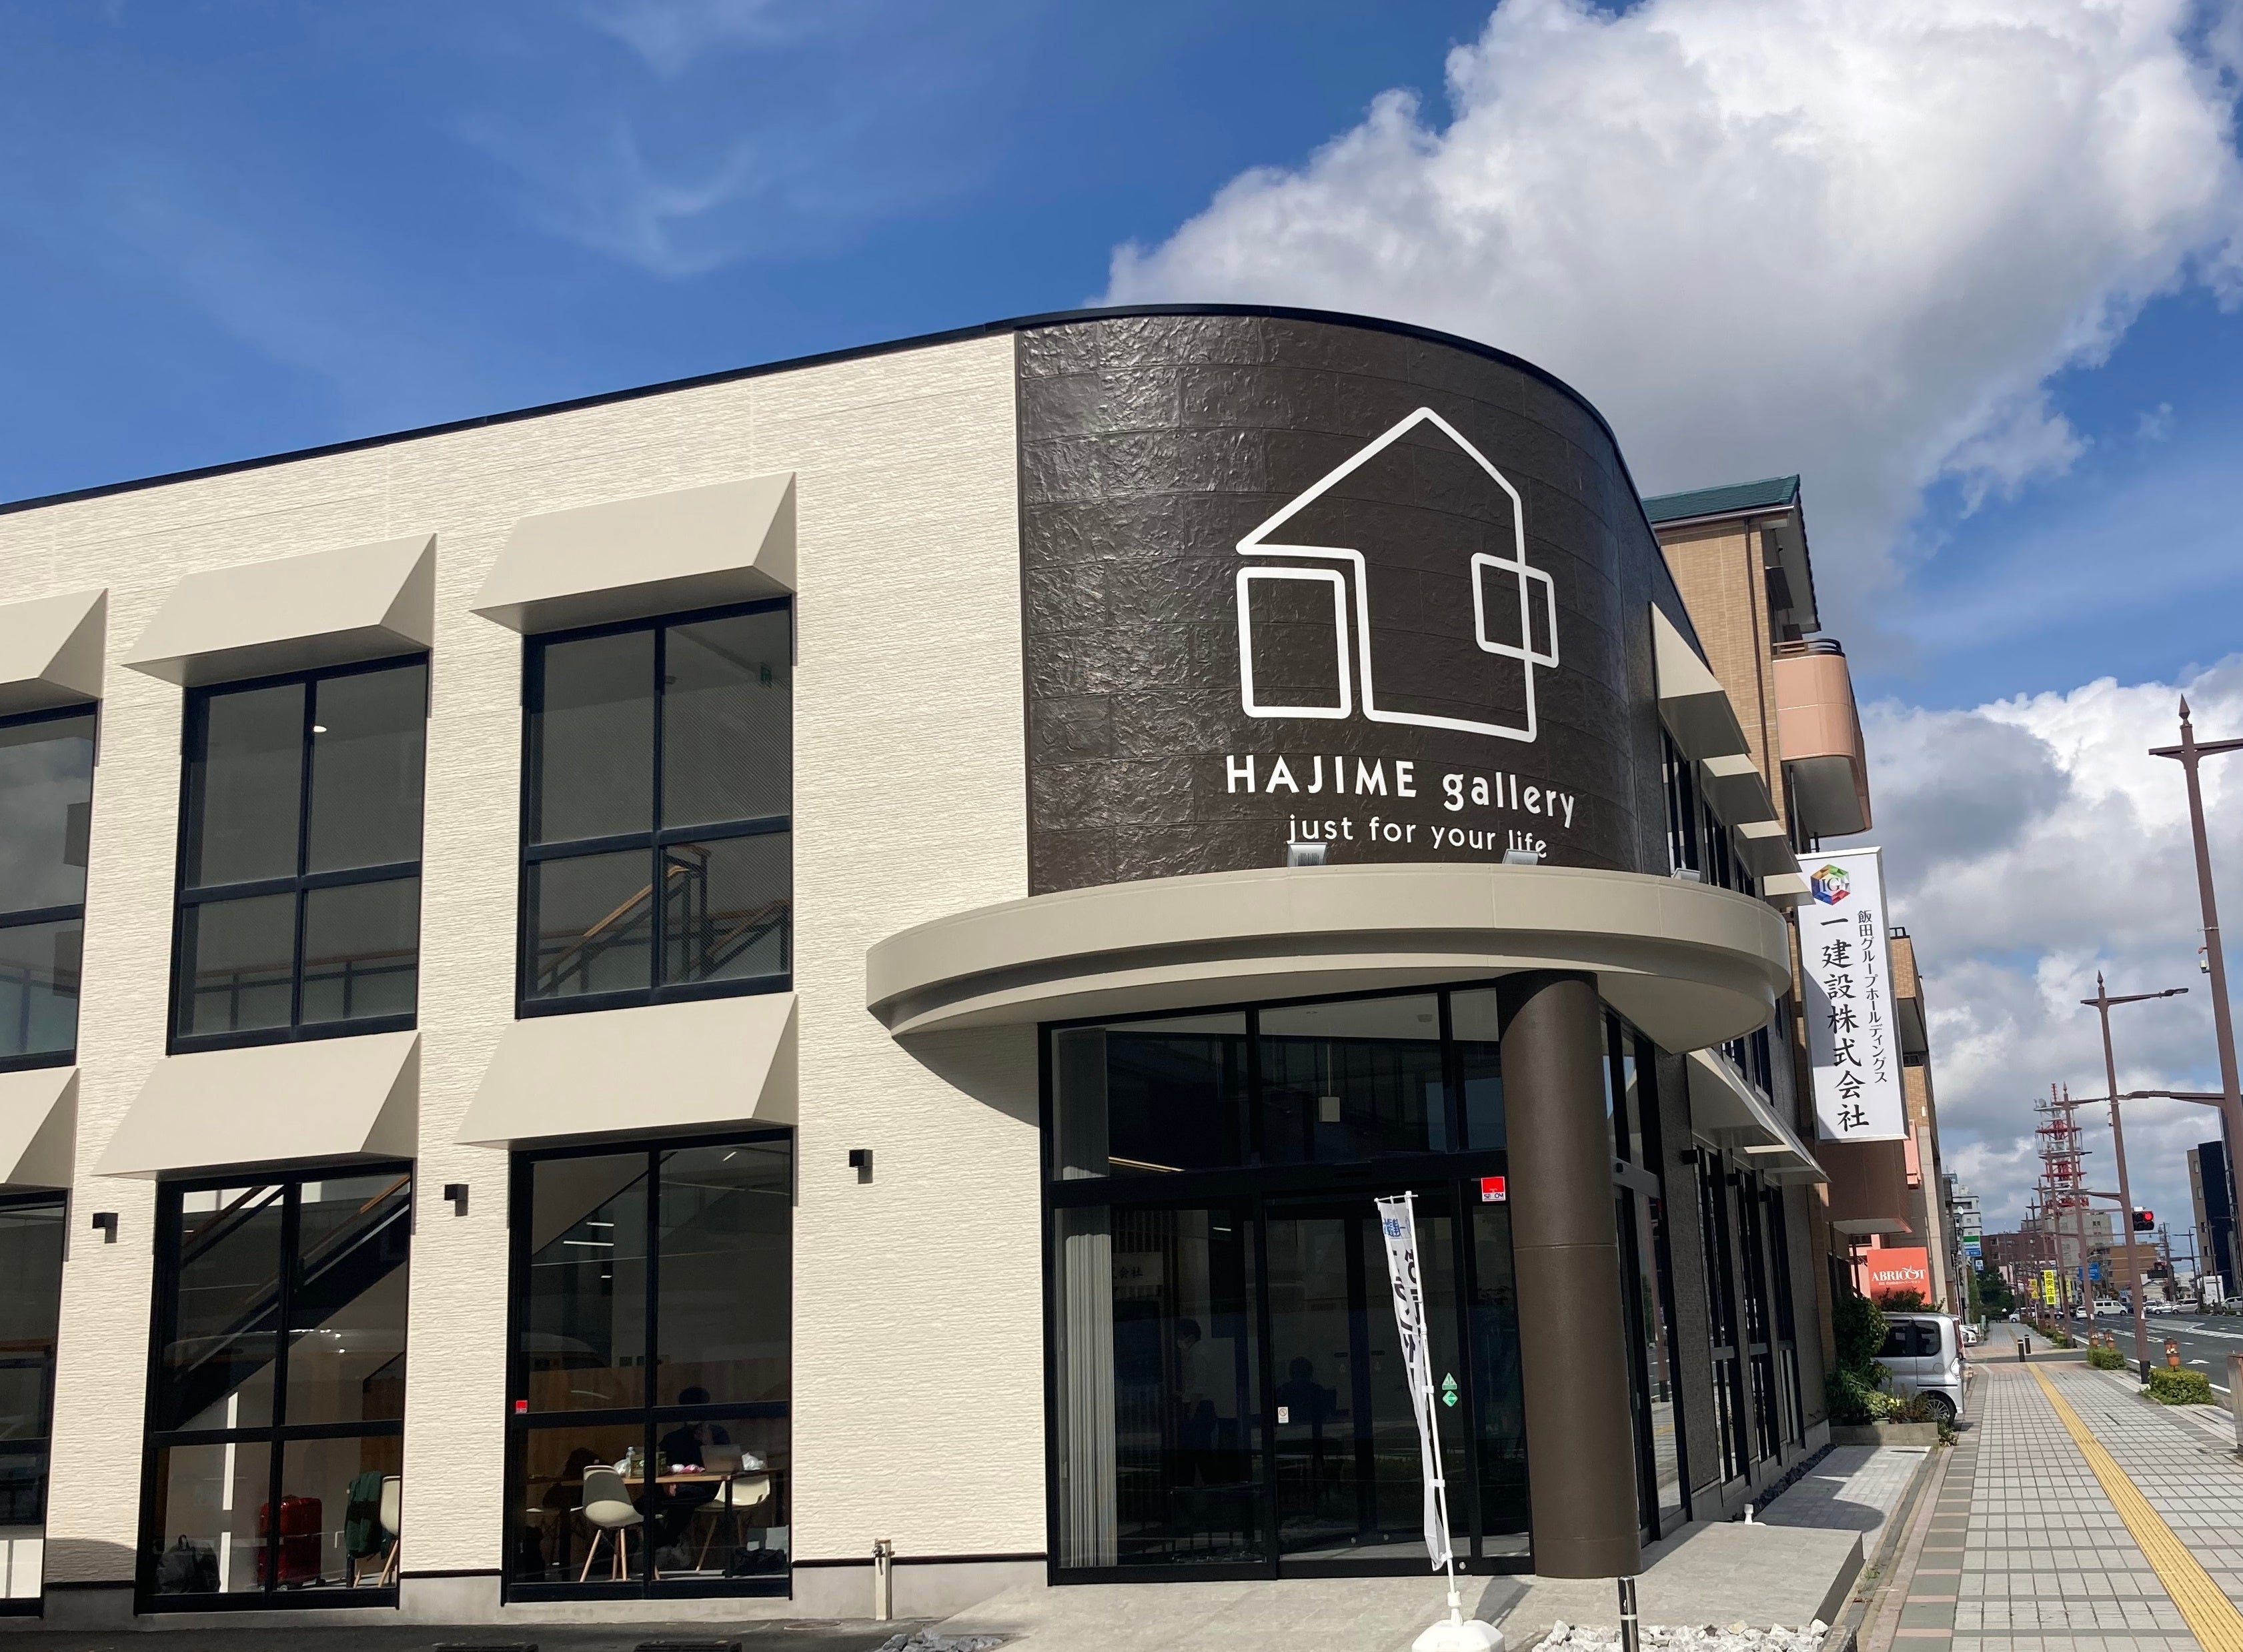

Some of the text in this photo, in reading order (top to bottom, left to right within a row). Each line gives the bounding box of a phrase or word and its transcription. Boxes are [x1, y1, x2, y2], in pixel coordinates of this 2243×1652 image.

[1226, 754, 1574, 828] HAJIME gallery
[1286, 814, 1547, 858] just for your life
[1820, 918, 1870, 1132] 一建設株式会社
[1857, 910, 1888, 1083] 飯田グループホールディングス
[1872, 1265, 1926, 1281] ABRICOT
